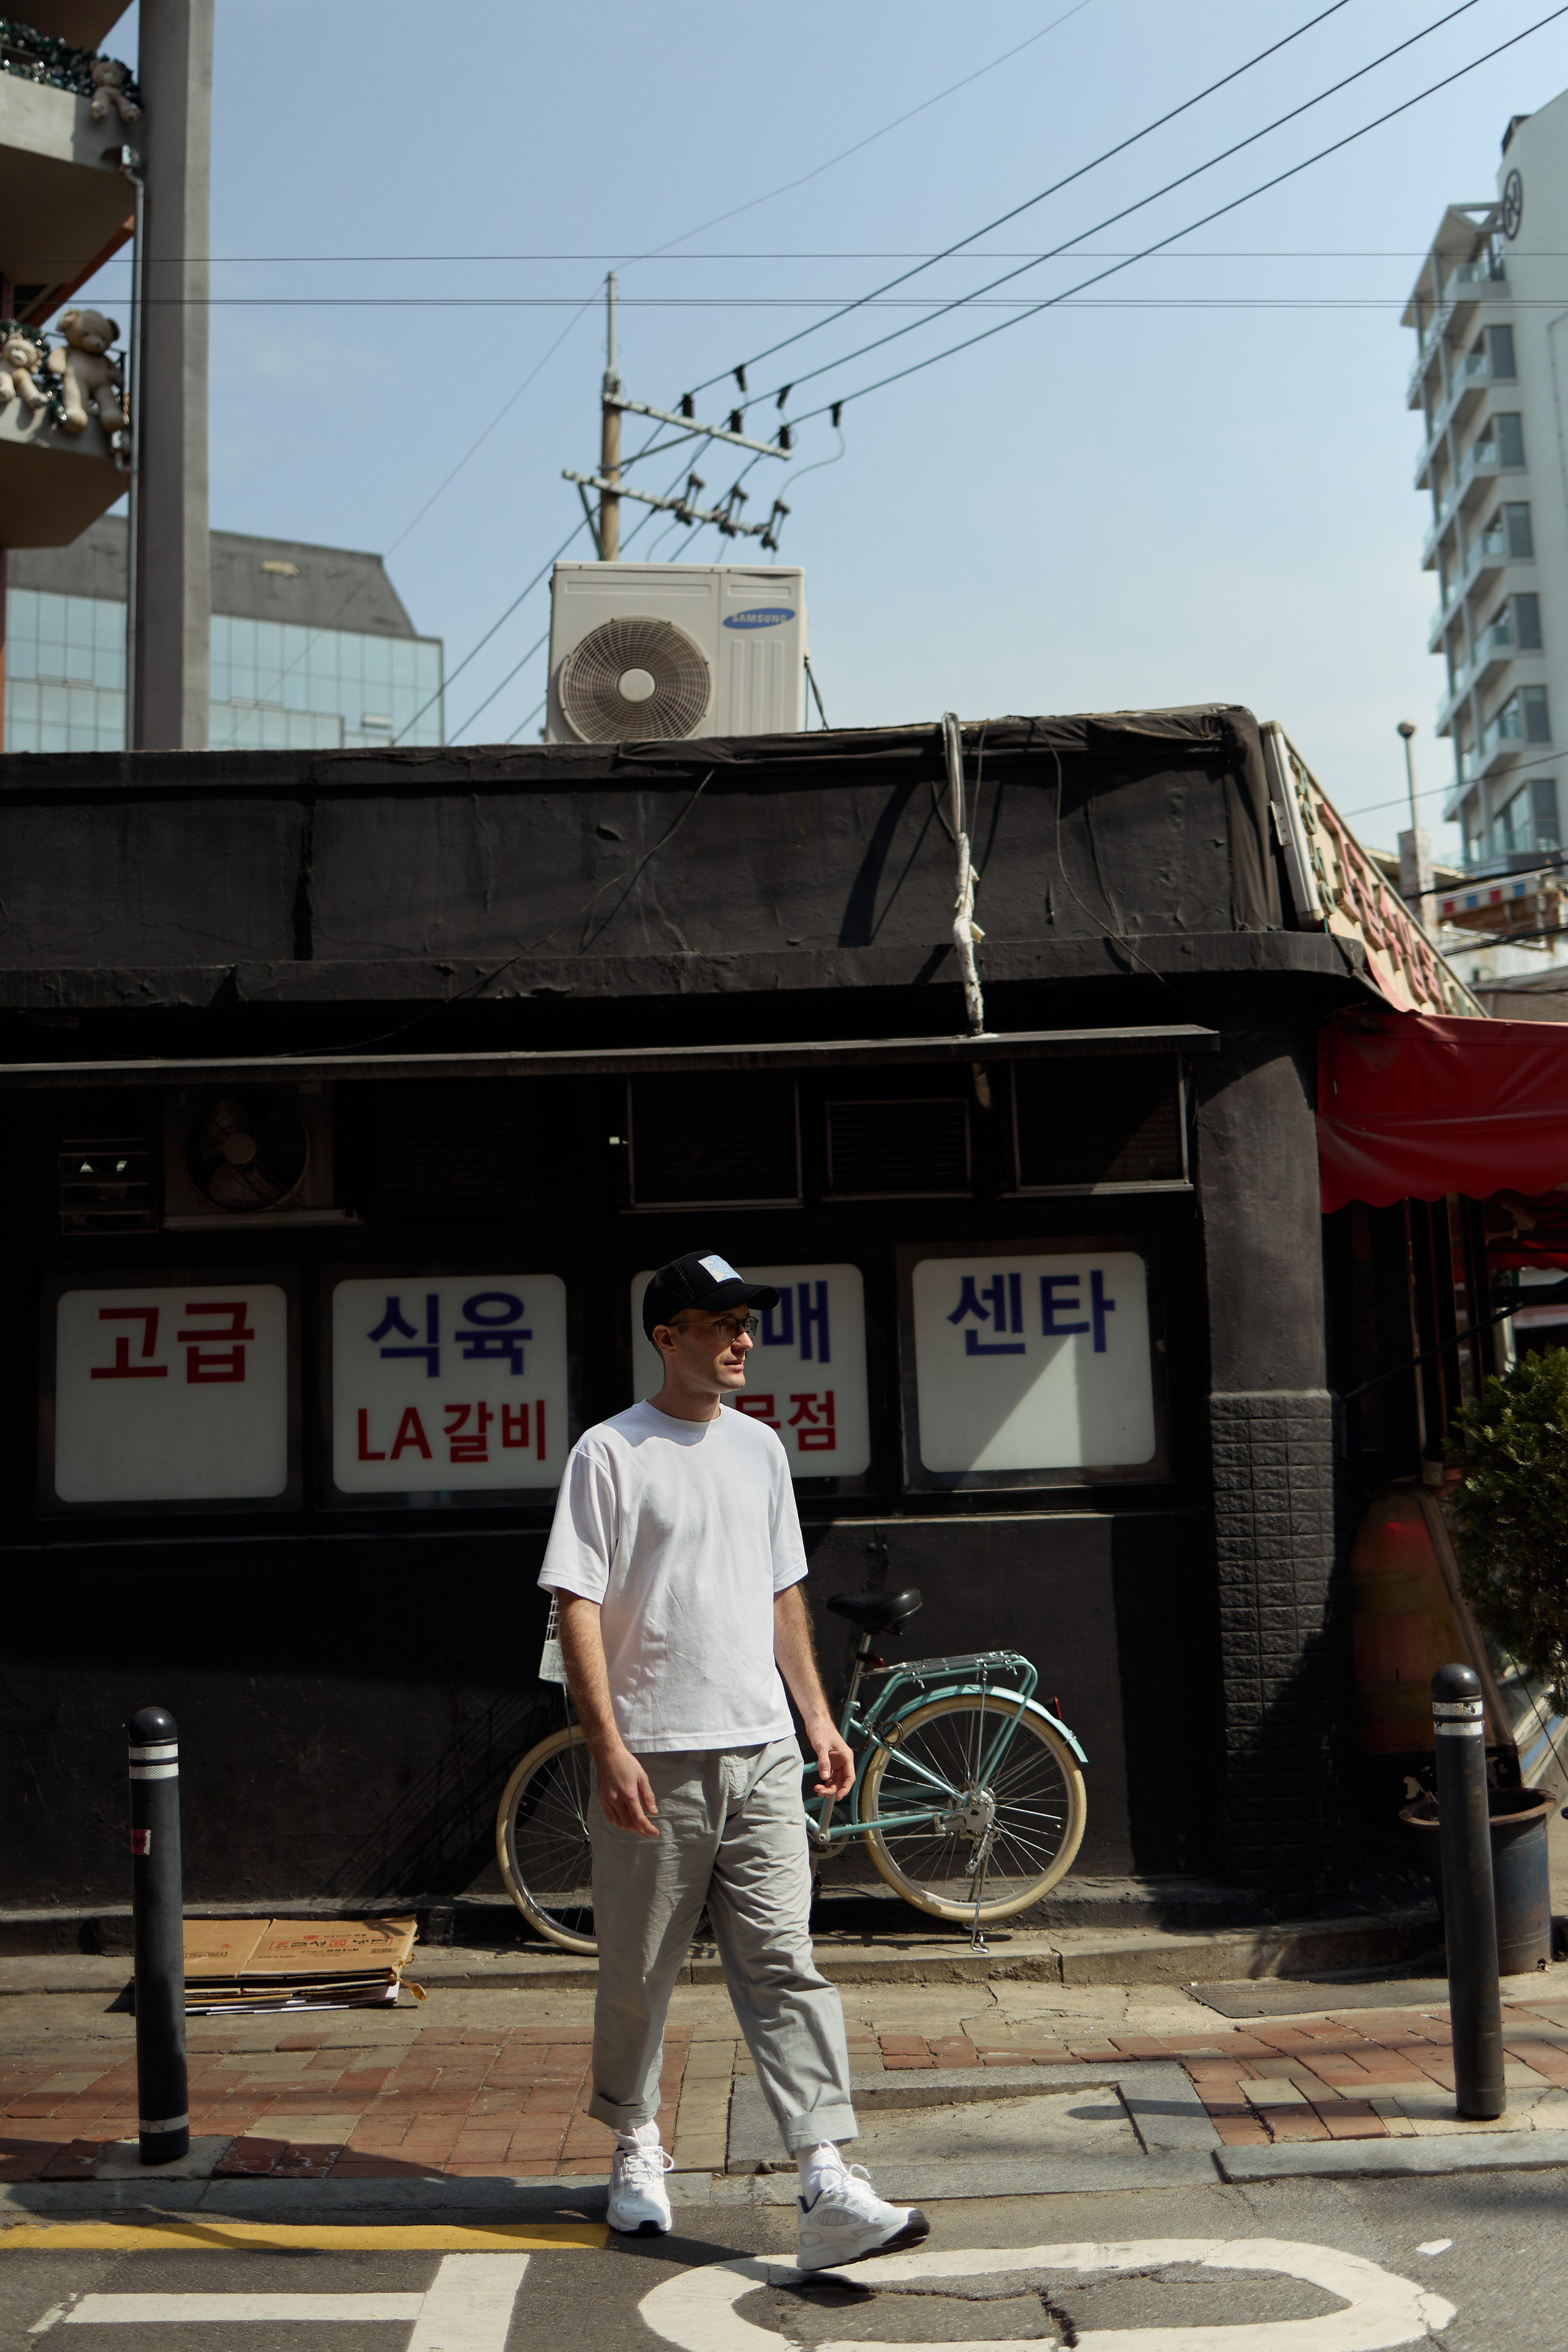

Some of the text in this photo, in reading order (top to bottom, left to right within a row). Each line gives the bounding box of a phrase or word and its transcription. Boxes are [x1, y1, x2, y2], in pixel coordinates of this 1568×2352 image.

[731, 613, 788, 624] SAMSUNG
[91, 1302, 255, 1384] 고급
[366, 1292, 532, 1378] 식육
[761, 1281, 831, 1363] 매
[946, 1270, 1115, 1355] 센타
[358, 1400, 546, 1463] LA갈비
